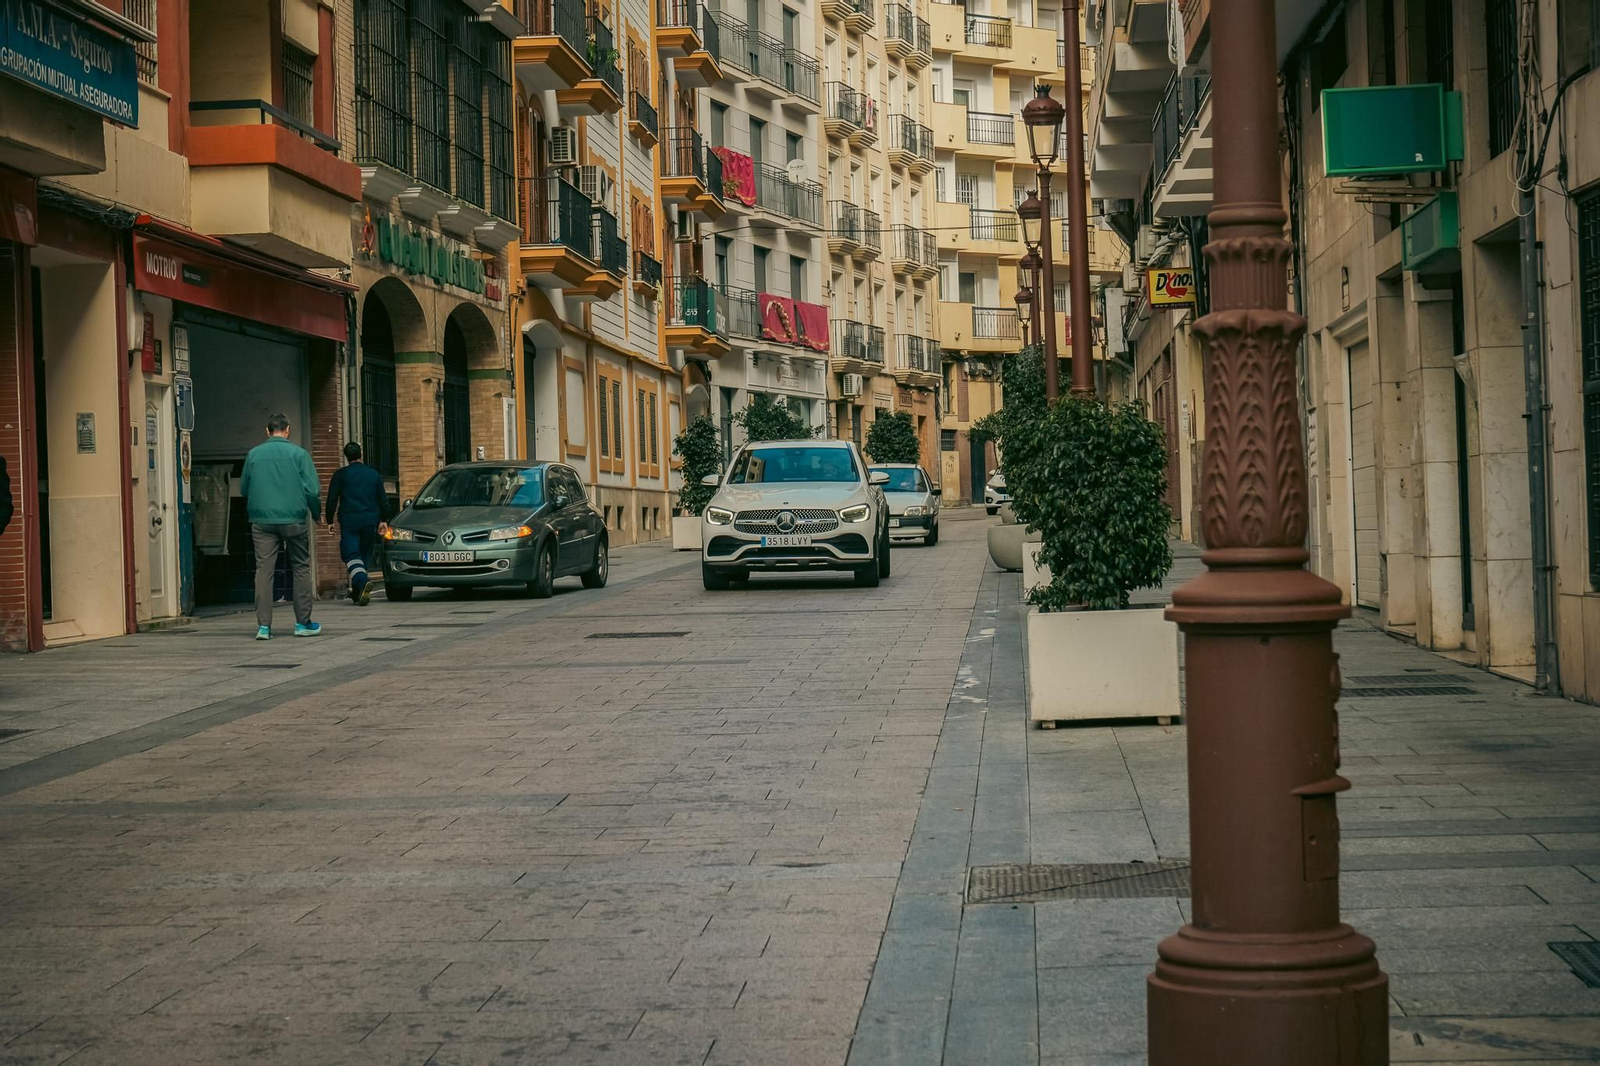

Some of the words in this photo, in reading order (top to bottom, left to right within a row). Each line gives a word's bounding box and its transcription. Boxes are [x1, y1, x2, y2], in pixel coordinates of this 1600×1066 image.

[70, 22, 113, 75] Seguros
[47, 67, 79, 97] MUTUAL
[79, 82, 134, 120] ASEGURADORA
[146, 252, 177, 280] MOTRIO
[767, 537, 789, 546] 3518
[791, 537, 808, 546] LVY
[429, 552, 451, 562] 8031
[454, 552, 471, 562] GGC
